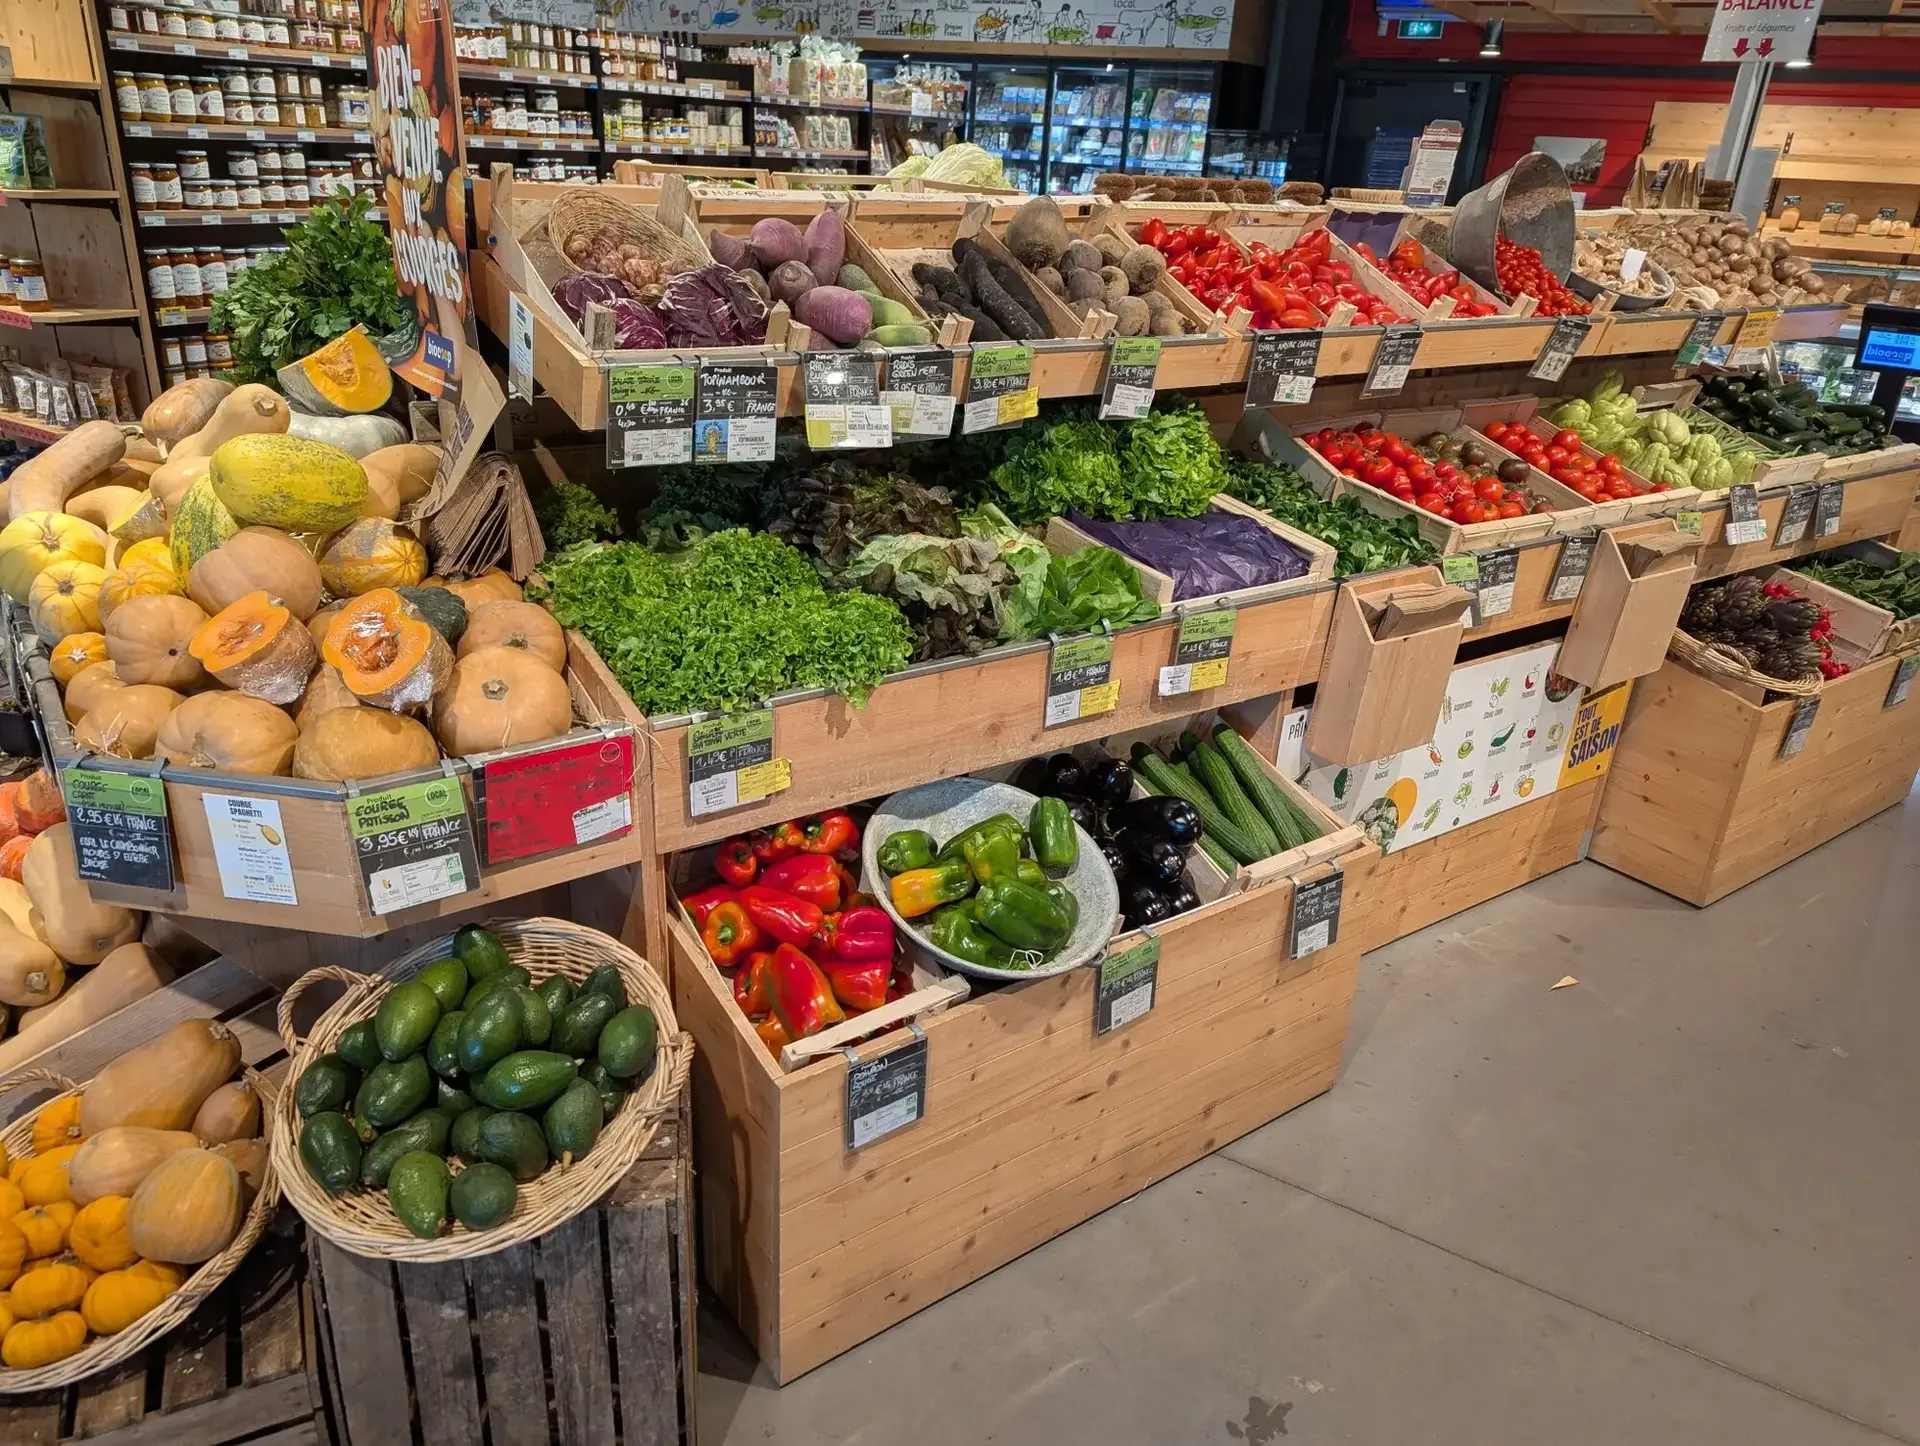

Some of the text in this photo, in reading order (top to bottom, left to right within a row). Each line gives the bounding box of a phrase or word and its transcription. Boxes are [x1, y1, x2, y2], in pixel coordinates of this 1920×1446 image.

[1724, 23, 1746, 32] Fruits
[1756, 22, 1796, 33] Légumes
[376, 43, 422, 110] BIEN-
[390, 117, 443, 184] VENUE
[402, 186, 424, 230] AUX
[393, 227, 463, 304] COURGES
[428, 336, 452, 369] biocoop
[1868, 345, 1912, 362] biocoop
[700, 372, 766, 387] TOPINAMBOUR
[702, 399, 735, 413] 3,95 €
[1577, 702, 1598, 726] TOUT
[1574, 716, 1602, 742] EST DE
[1568, 722, 1620, 769] SAISON
[72, 779, 108, 793] COURGE
[426, 790, 448, 801] LOCAL
[228, 799, 252, 809] COURGE
[366, 794, 392, 804] Produit
[77, 807, 103, 824] 2,95
[104, 814, 114, 826] €
[127, 814, 158, 831] FRANCE
[230, 808, 263, 818] SPAGHETTI
[359, 807, 410, 829] PATISSON
[422, 818, 461, 840] FRANCE
[360, 831, 398, 852] 3,95
[397, 831, 409, 845] €
